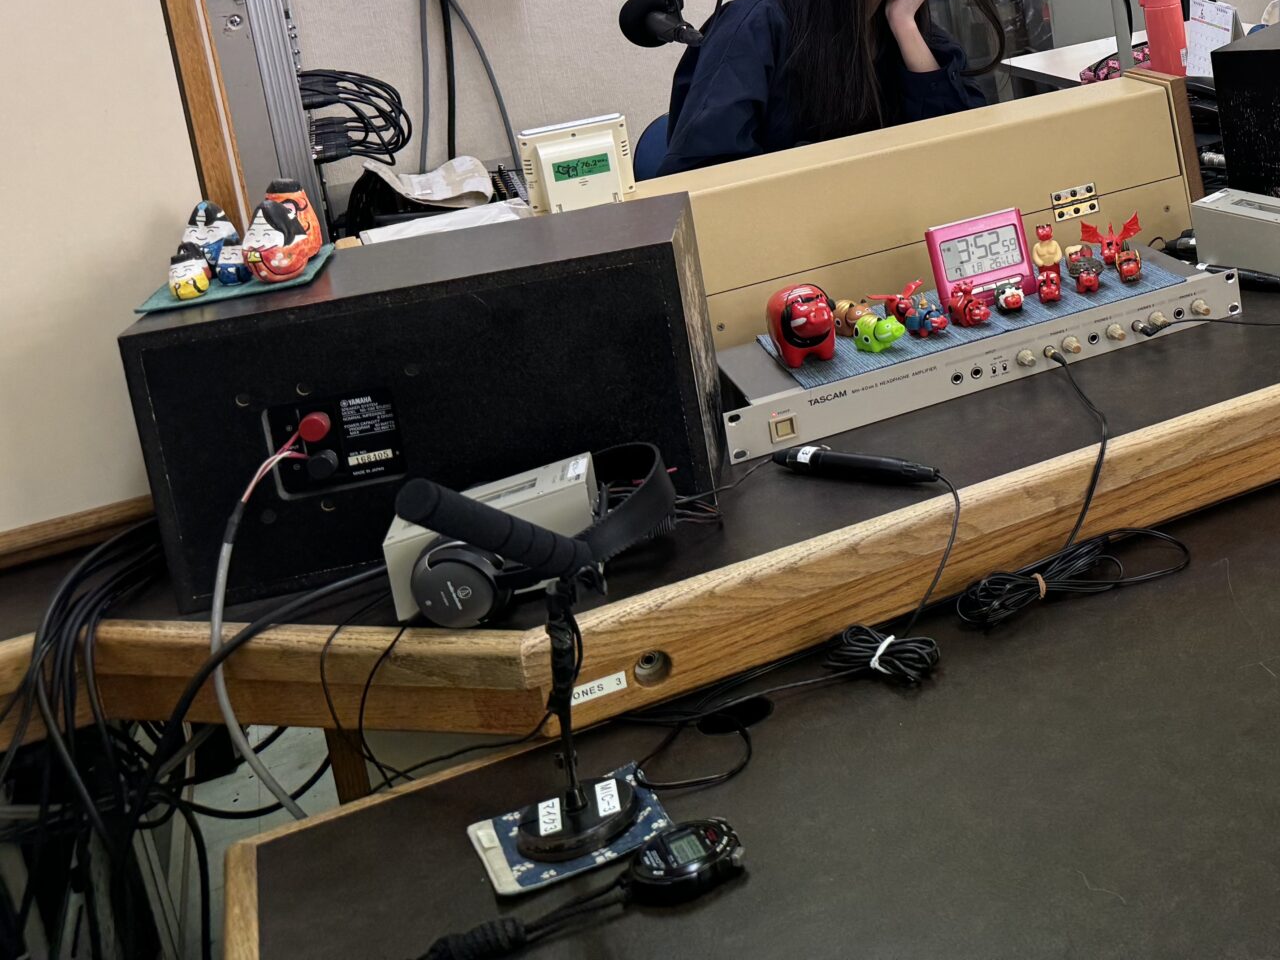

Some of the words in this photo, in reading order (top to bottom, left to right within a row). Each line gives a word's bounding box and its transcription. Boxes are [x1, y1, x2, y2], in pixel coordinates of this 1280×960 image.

[957, 230, 1001, 265] 3:52
[348, 396, 372, 406] YAMAHA
[808, 390, 847, 407] TASCAM
[880, 374, 909, 386] HEADPHONE
[912, 366, 938, 376] AMPLIFIER
[573, 683, 604, 700] ONES
[615, 677, 622, 686] 3
[600, 783, 615, 813] MIC-3
